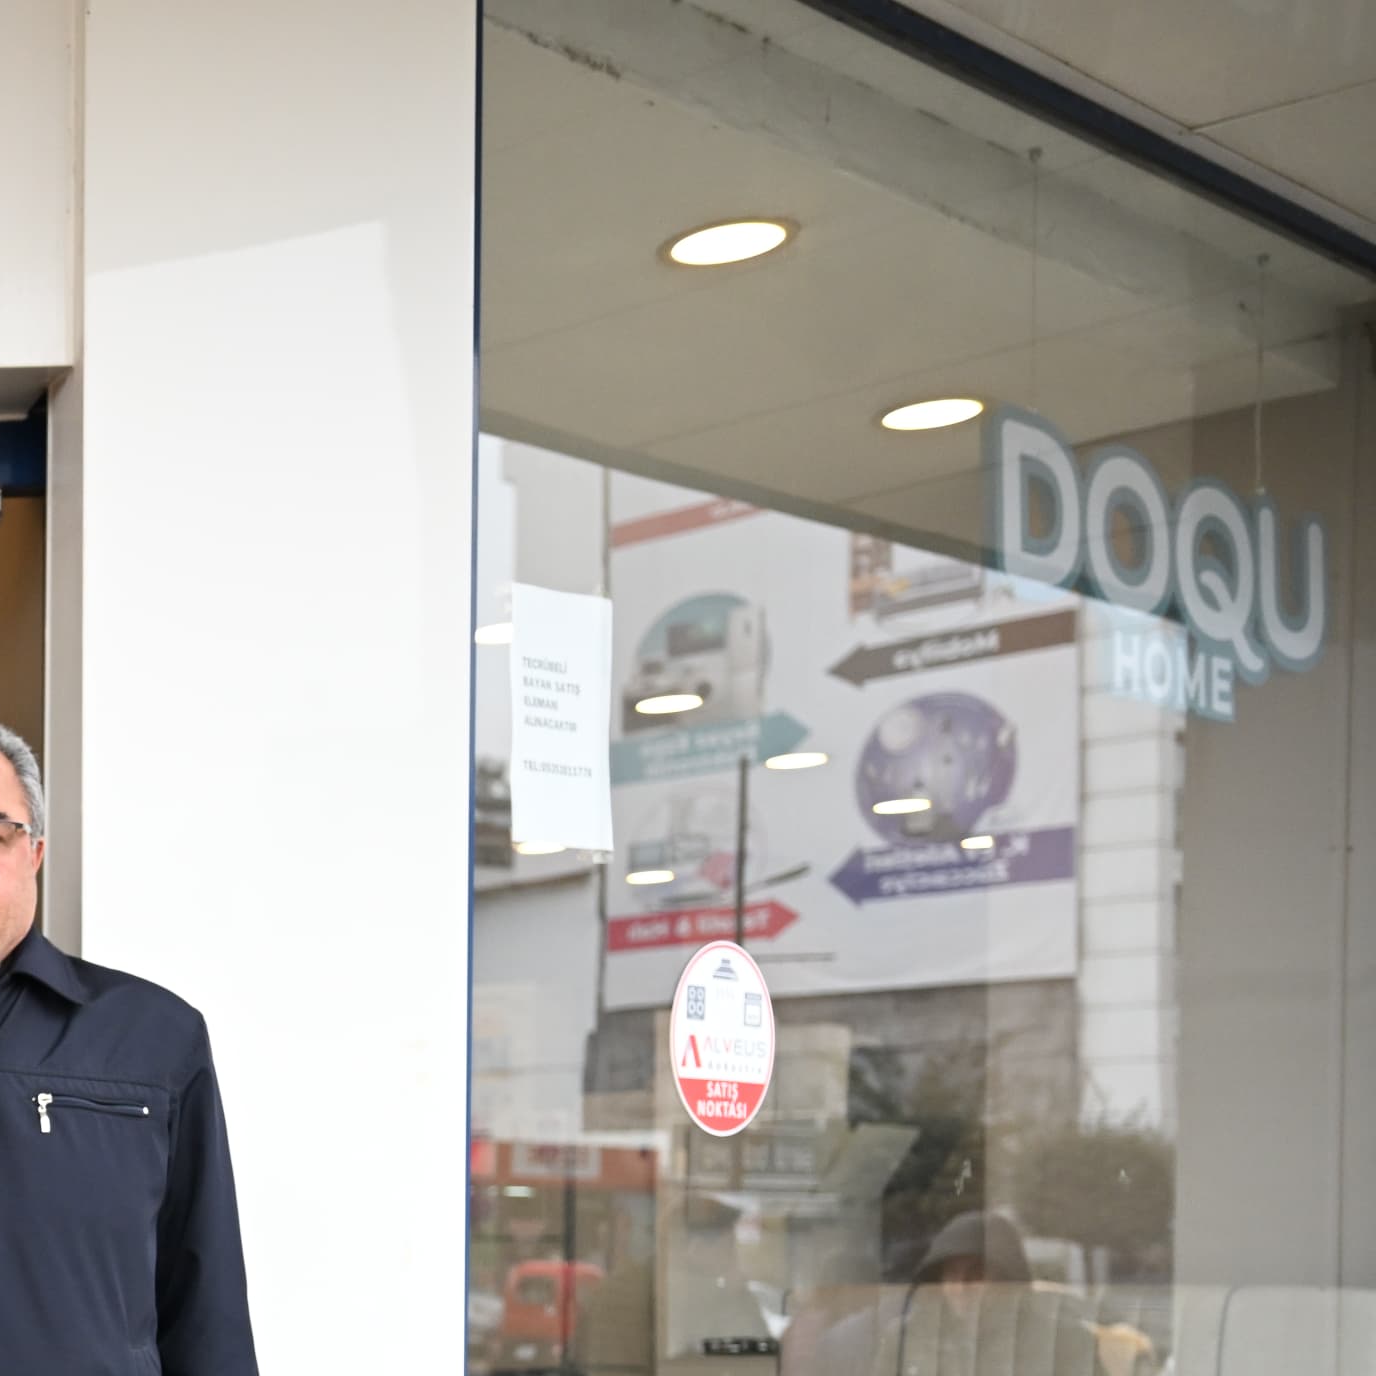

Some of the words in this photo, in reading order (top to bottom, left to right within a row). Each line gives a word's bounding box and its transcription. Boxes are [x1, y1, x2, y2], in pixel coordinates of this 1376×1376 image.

[998, 412, 1328, 676] DOQU
[1111, 627, 1235, 717] HOME
[703, 1035, 767, 1058] ALVEUS
[706, 1081, 739, 1101] SATIŞ
[696, 1100, 748, 1120] NOKTASI
